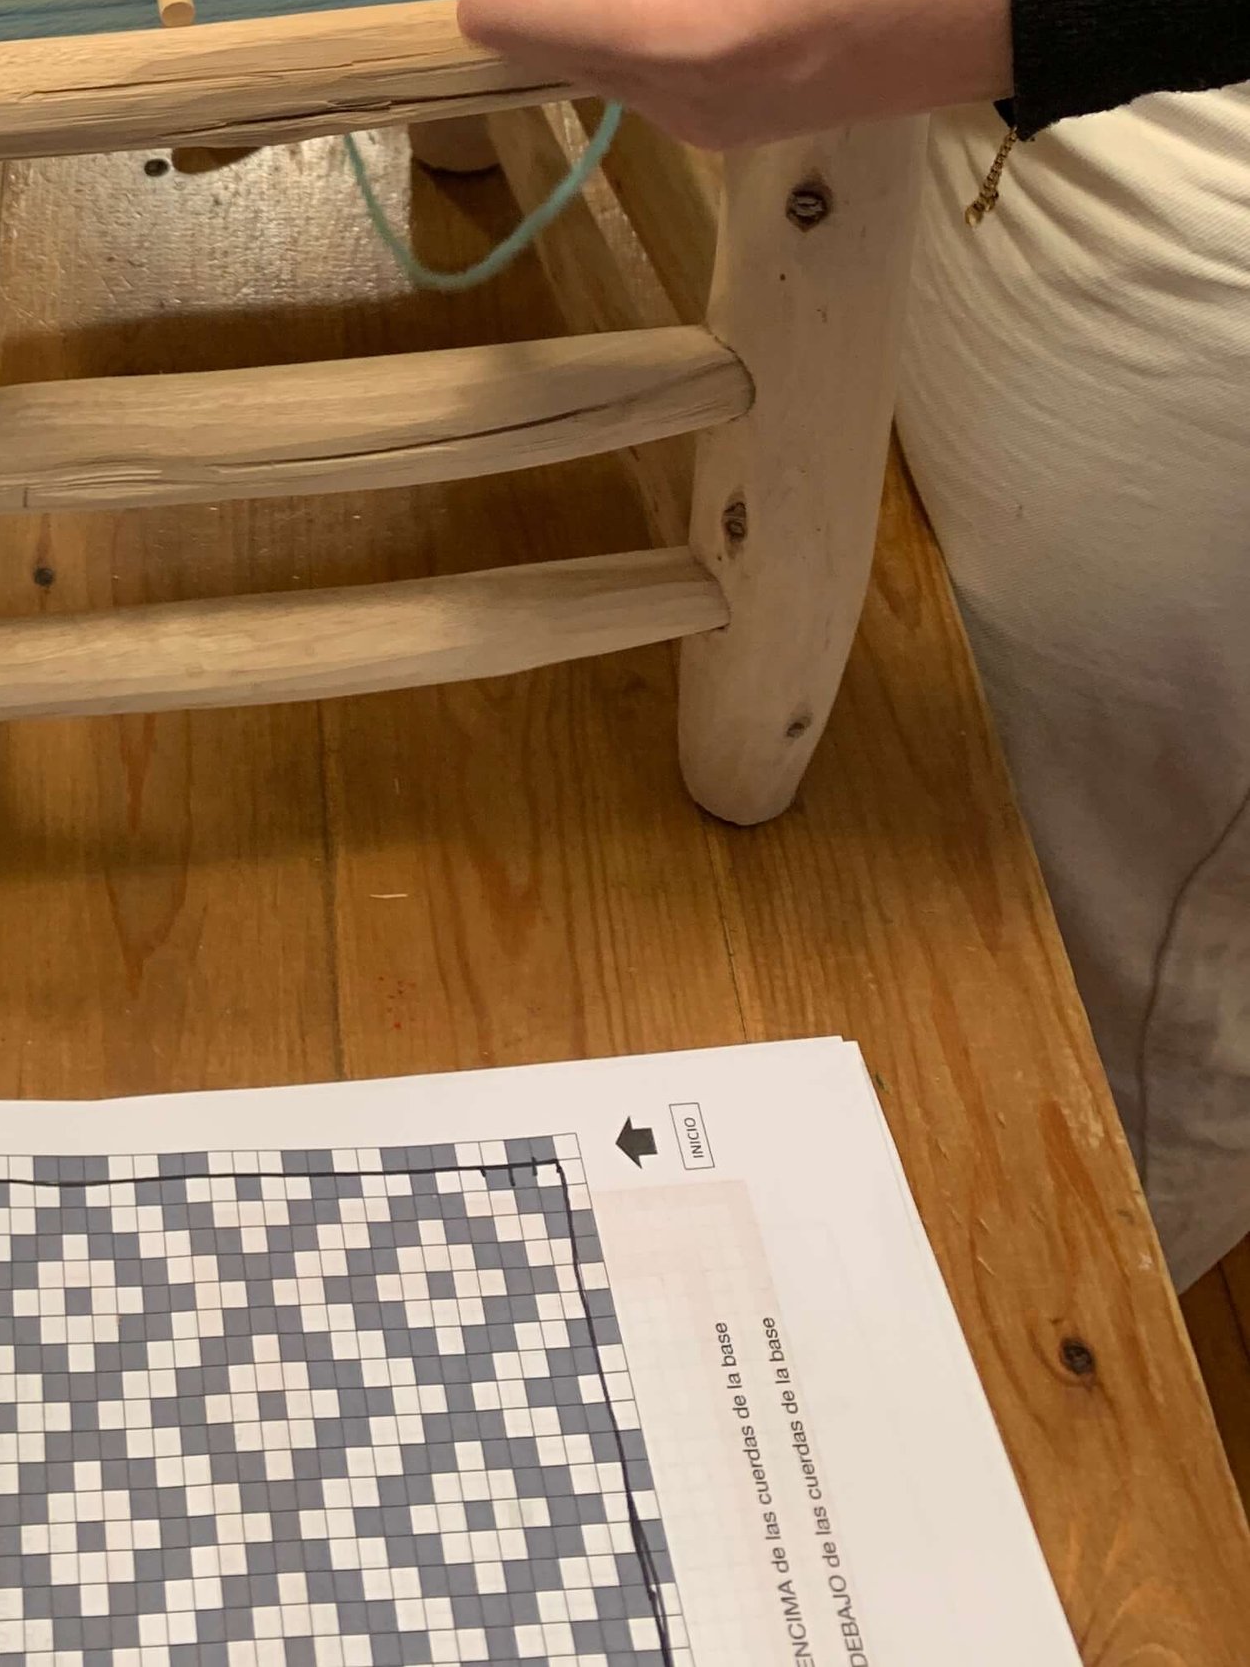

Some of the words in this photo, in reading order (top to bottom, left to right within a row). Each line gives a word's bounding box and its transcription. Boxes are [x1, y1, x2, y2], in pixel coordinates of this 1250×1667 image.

[684, 1117, 704, 1158] INICIO
[715, 1322, 737, 1367] base
[763, 1317, 785, 1362] base
[727, 1372, 742, 1389] la
[775, 1367, 791, 1384] la
[732, 1395, 750, 1419] de
[781, 1390, 799, 1414] de
[741, 1425, 772, 1505] cuerdas
[790, 1420, 822, 1500] cuerdas
[763, 1511, 781, 1540] las
[813, 1506, 832, 1536] las
[771, 1546, 790, 1573] de
[822, 1541, 840, 1568] de
[828, 1574, 869, 1667] DEBAJO
